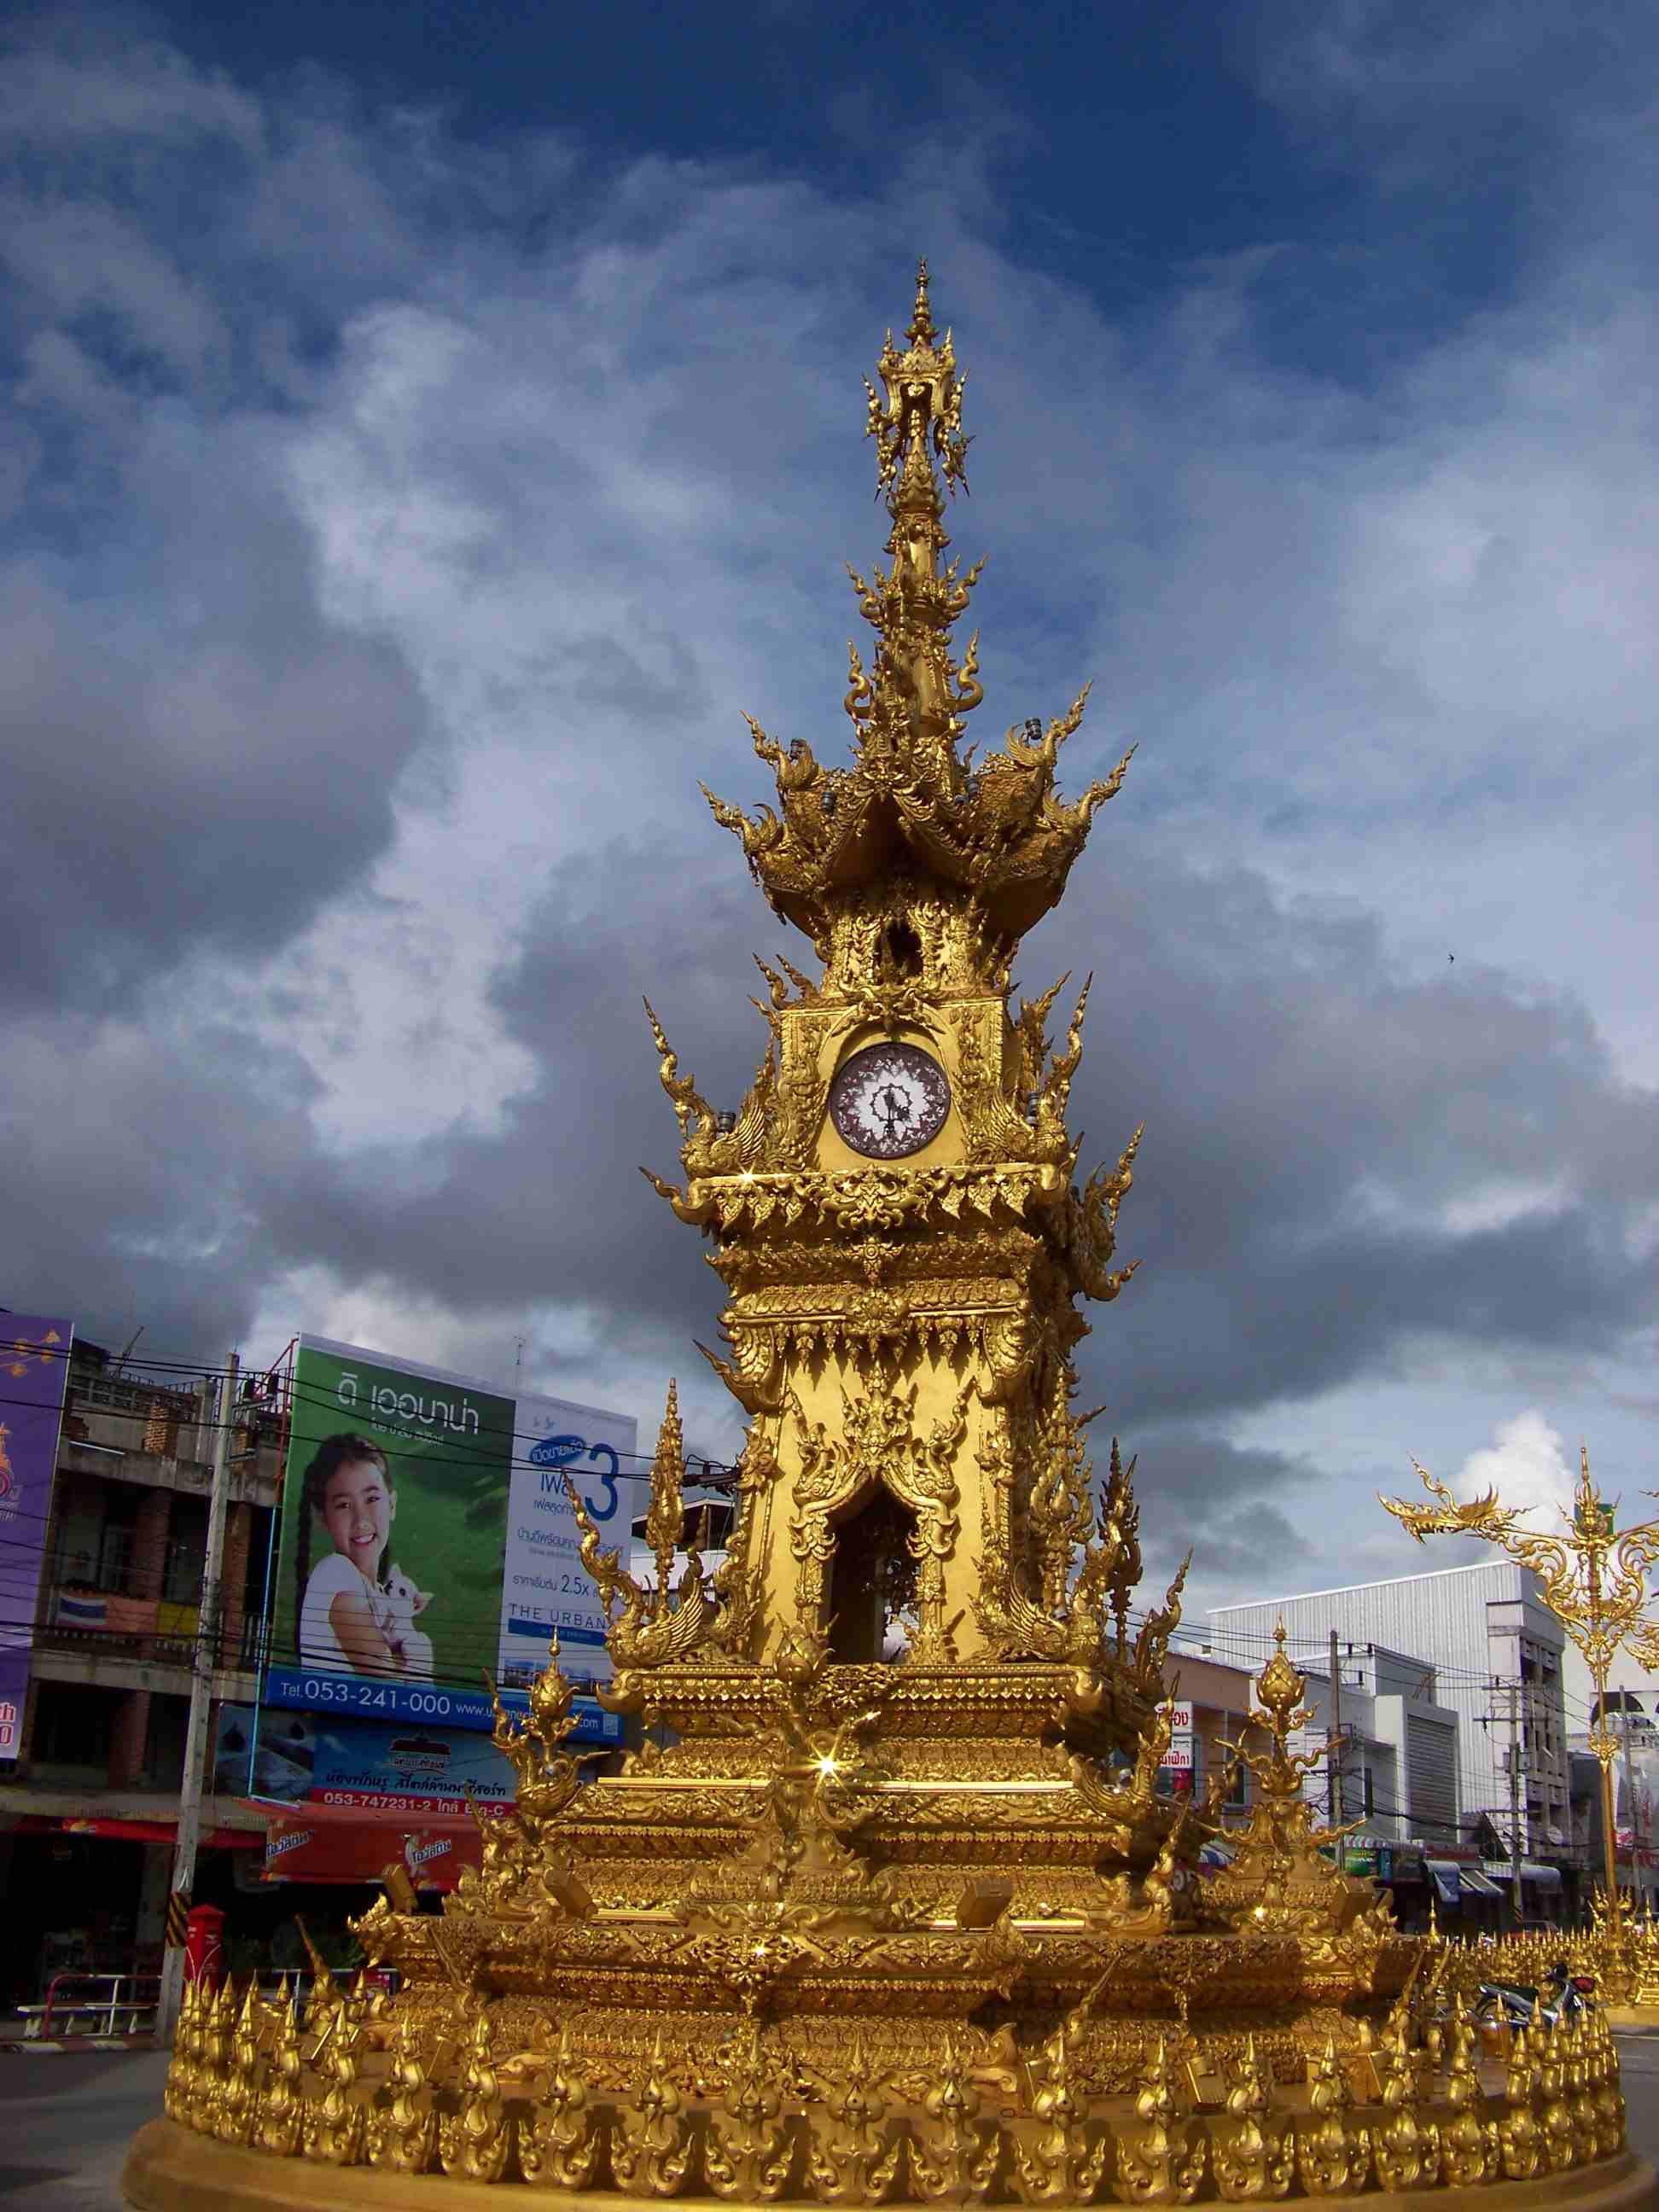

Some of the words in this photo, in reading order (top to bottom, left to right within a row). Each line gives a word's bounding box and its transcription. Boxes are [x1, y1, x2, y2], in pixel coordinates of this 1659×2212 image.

[585, 1443, 620, 1521] 3
[561, 1574, 589, 1596] 2.5x
[509, 1603, 542, 1620] THE
[305, 1679, 451, 1715] 053-241-000
[324, 1792, 431, 1811] 053-747231-2
[464, 1802, 505, 1818] Bg-C
